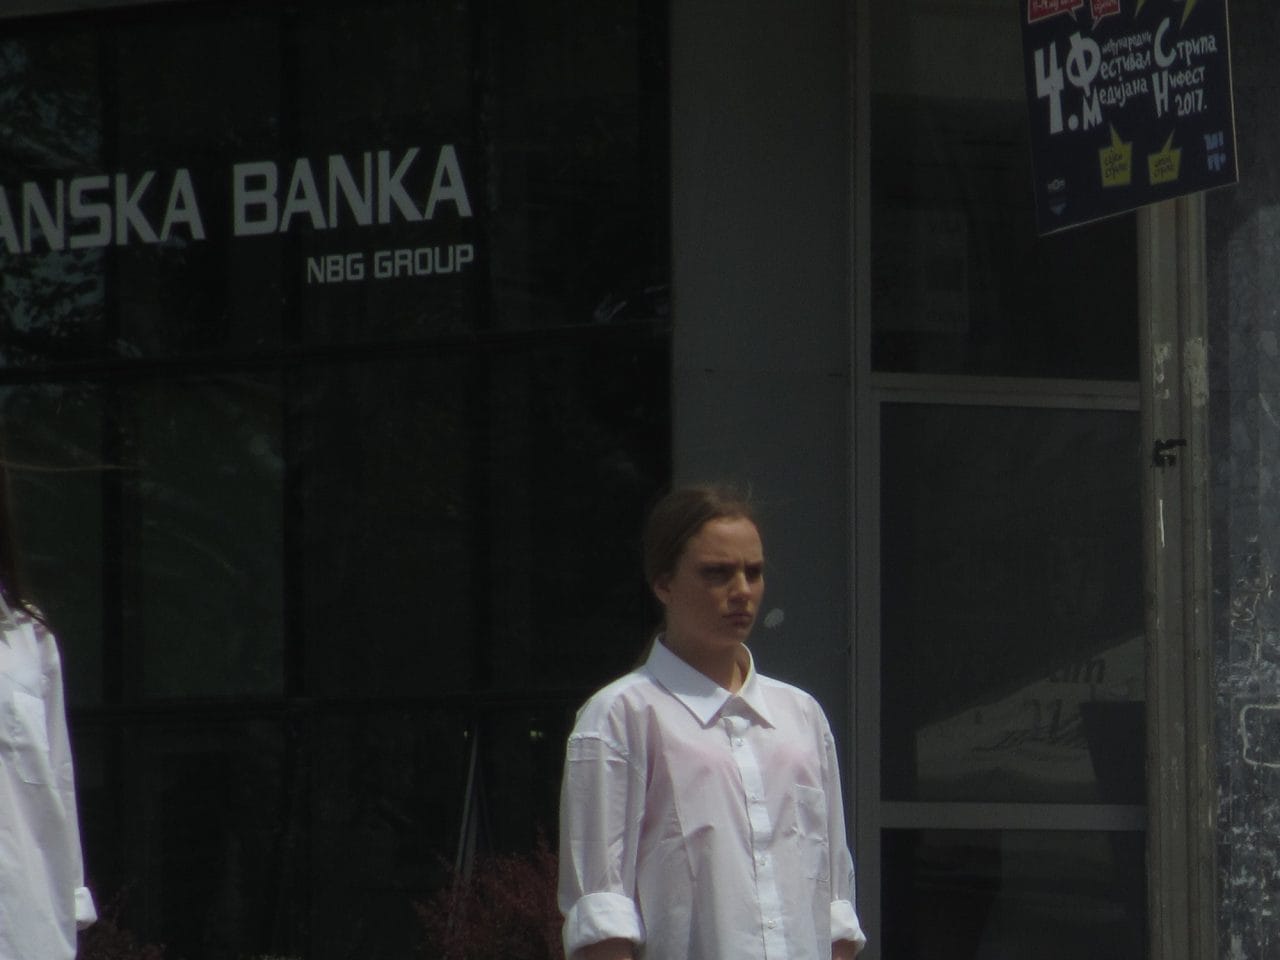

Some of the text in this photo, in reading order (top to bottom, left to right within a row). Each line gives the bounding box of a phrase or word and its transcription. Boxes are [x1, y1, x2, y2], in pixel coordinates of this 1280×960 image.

[232, 143, 474, 237] BANKA
[307, 243, 475, 284] NBG GROUP
